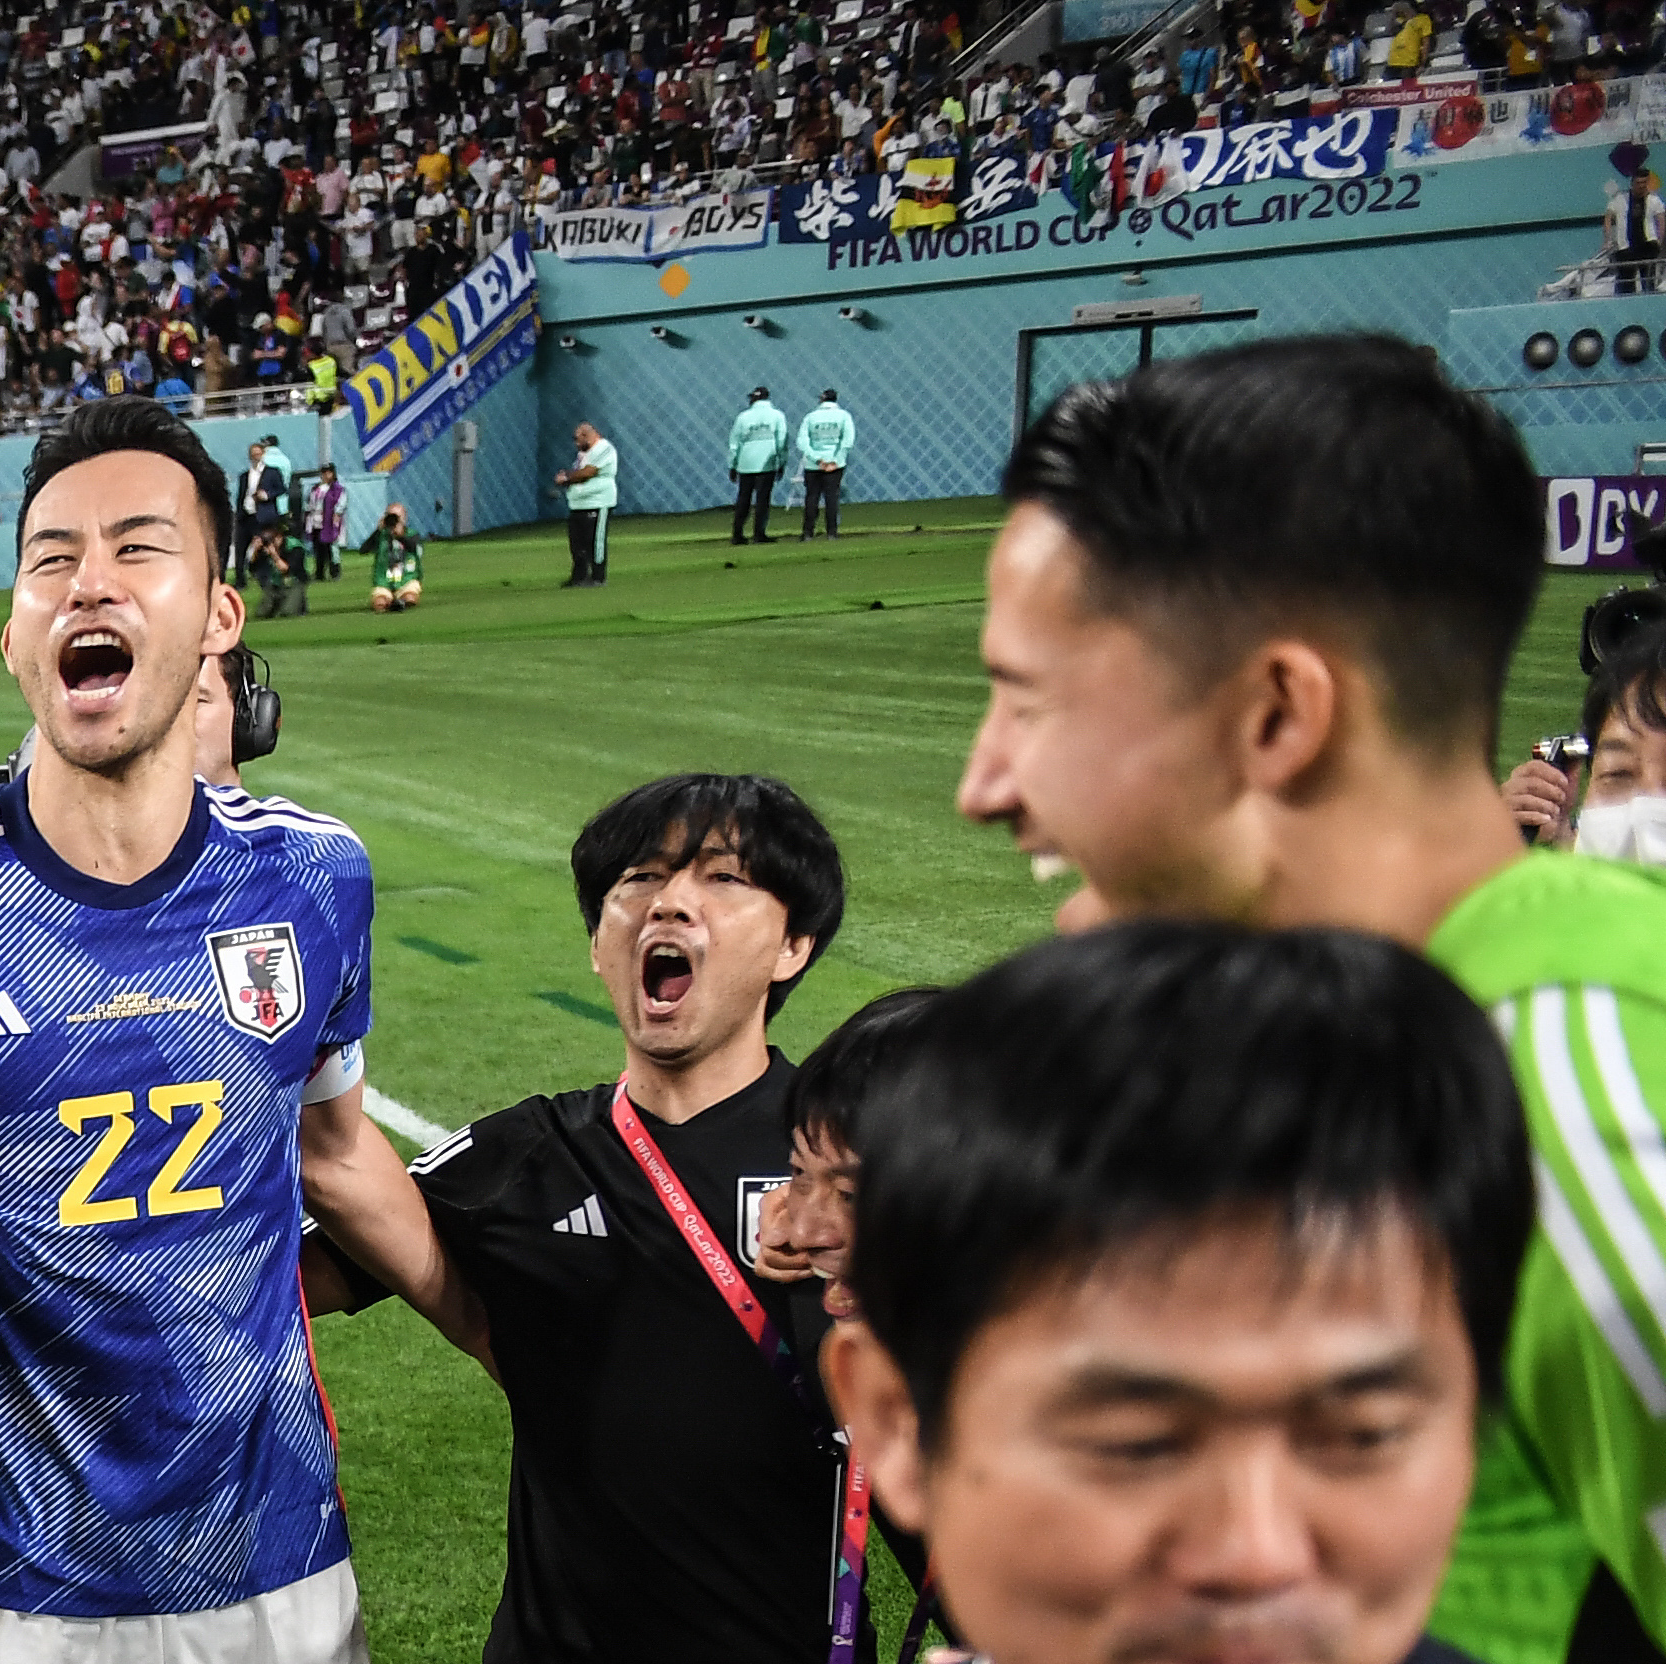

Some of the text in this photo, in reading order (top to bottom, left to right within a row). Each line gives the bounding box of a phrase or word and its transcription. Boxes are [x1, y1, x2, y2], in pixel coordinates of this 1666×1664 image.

[1347, 84, 1473, 104] Colchester United
[544, 202, 765, 252] KABUKI BOYS
[828, 231, 902, 270] FIFA
[909, 220, 1040, 261] WORLD
[349, 233, 536, 431] DANIEL
[230, 929, 276, 945] JAPAN
[251, 1001, 285, 1021] JFA
[58, 1079, 224, 1228] 22
[633, 1137, 652, 1162] FIFA
[646, 1157, 675, 1194] WORLD
[668, 1192, 688, 1212] CUP
